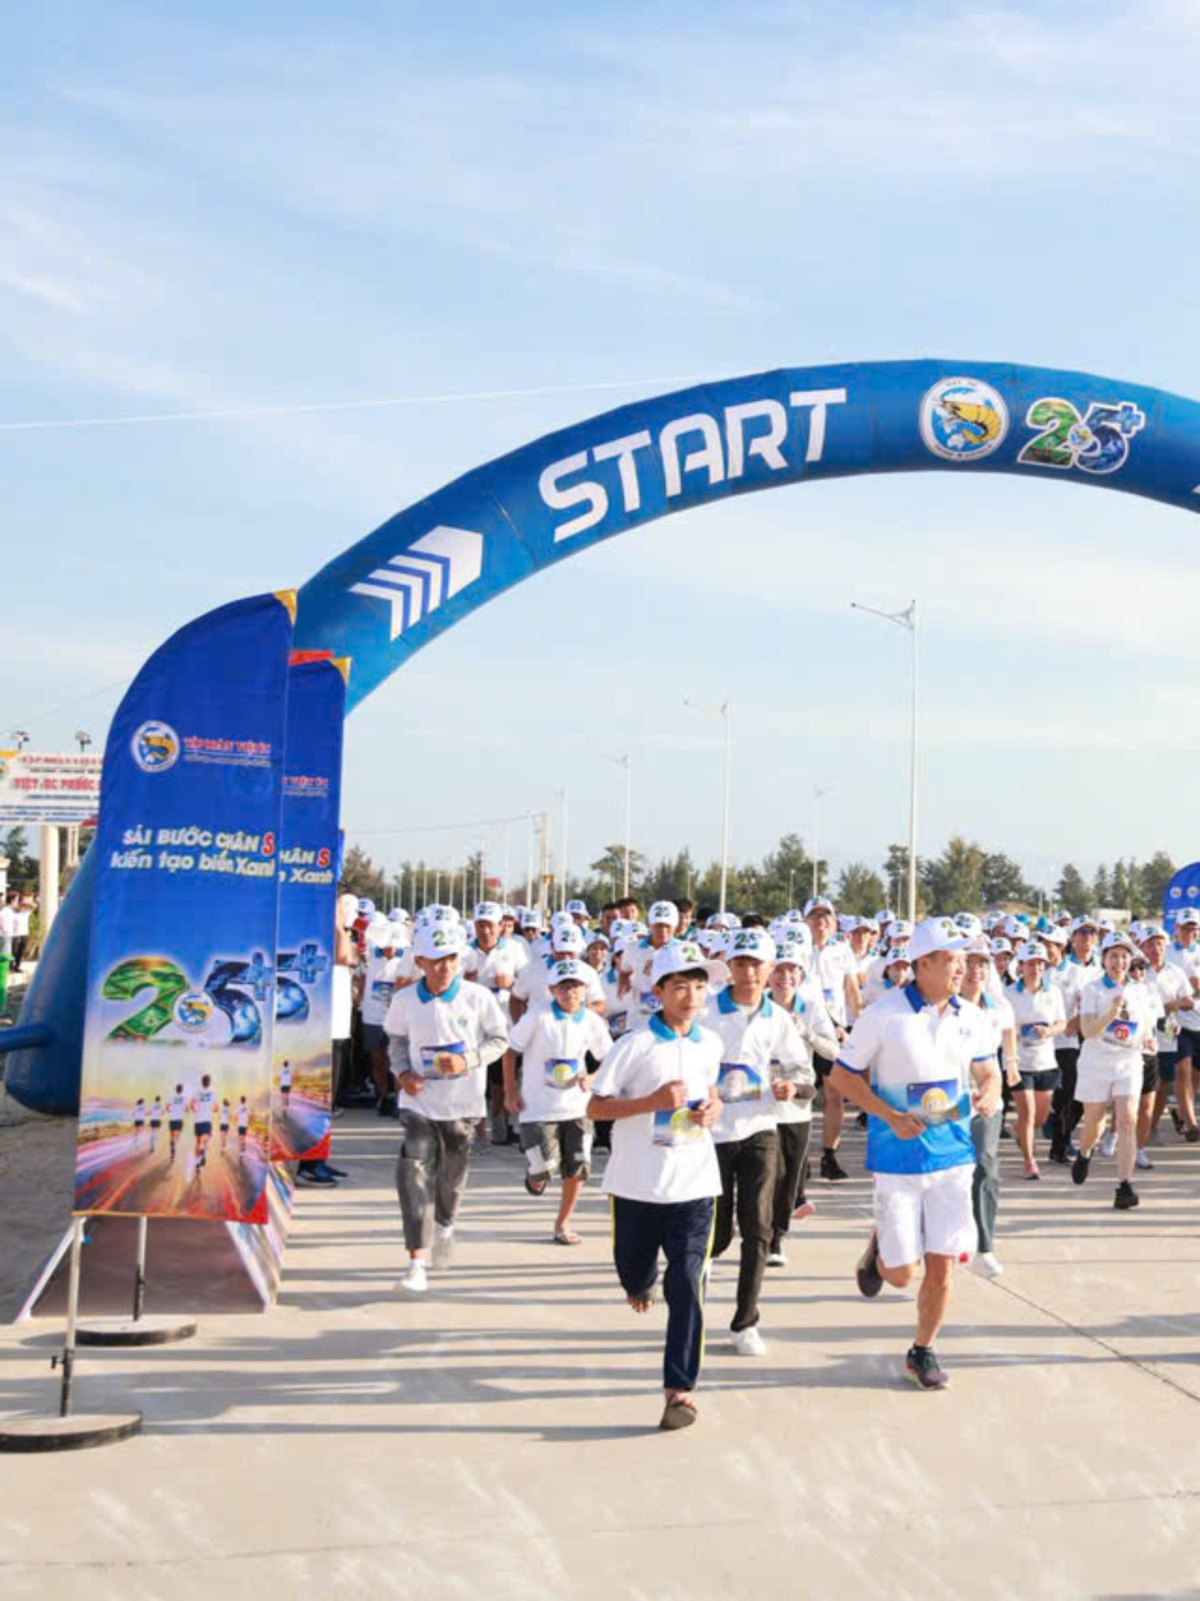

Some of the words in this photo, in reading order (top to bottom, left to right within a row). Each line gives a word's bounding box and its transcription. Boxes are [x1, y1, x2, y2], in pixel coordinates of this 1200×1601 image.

[538, 388, 847, 543] START
[261, 831, 275, 856] S
[158, 851, 195, 874] tạo
[279, 847, 315, 865] HÂN
[316, 847, 331, 868] S
